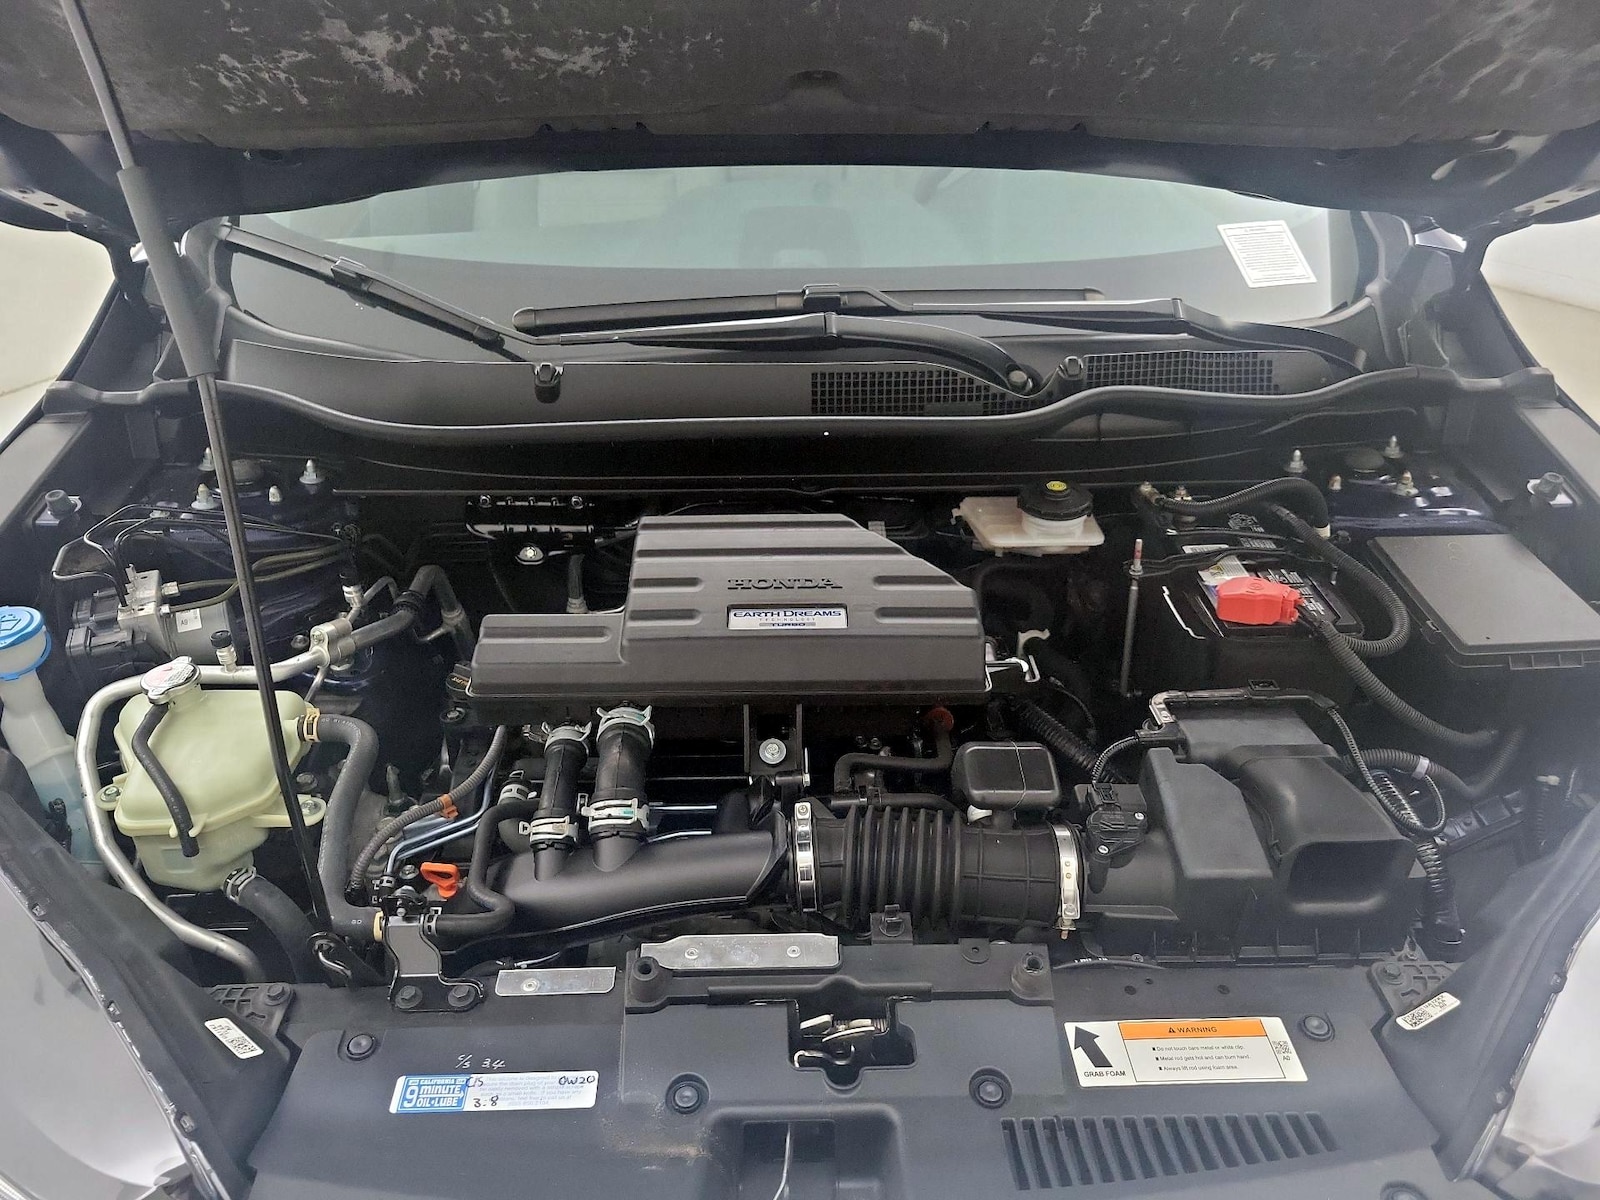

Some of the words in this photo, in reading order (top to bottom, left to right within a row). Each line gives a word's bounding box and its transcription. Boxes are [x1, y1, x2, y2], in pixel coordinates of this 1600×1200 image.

[727, 578, 843, 590] HONDA
[733, 610, 780, 618] EARTH
[1177, 1026, 1218, 1034] WARNING
[1083, 1070, 1104, 1078] GRAB
[1105, 1069, 1126, 1077] FOAM
[419, 1084, 462, 1095] MINUTE
[403, 1085, 419, 1108] 9
